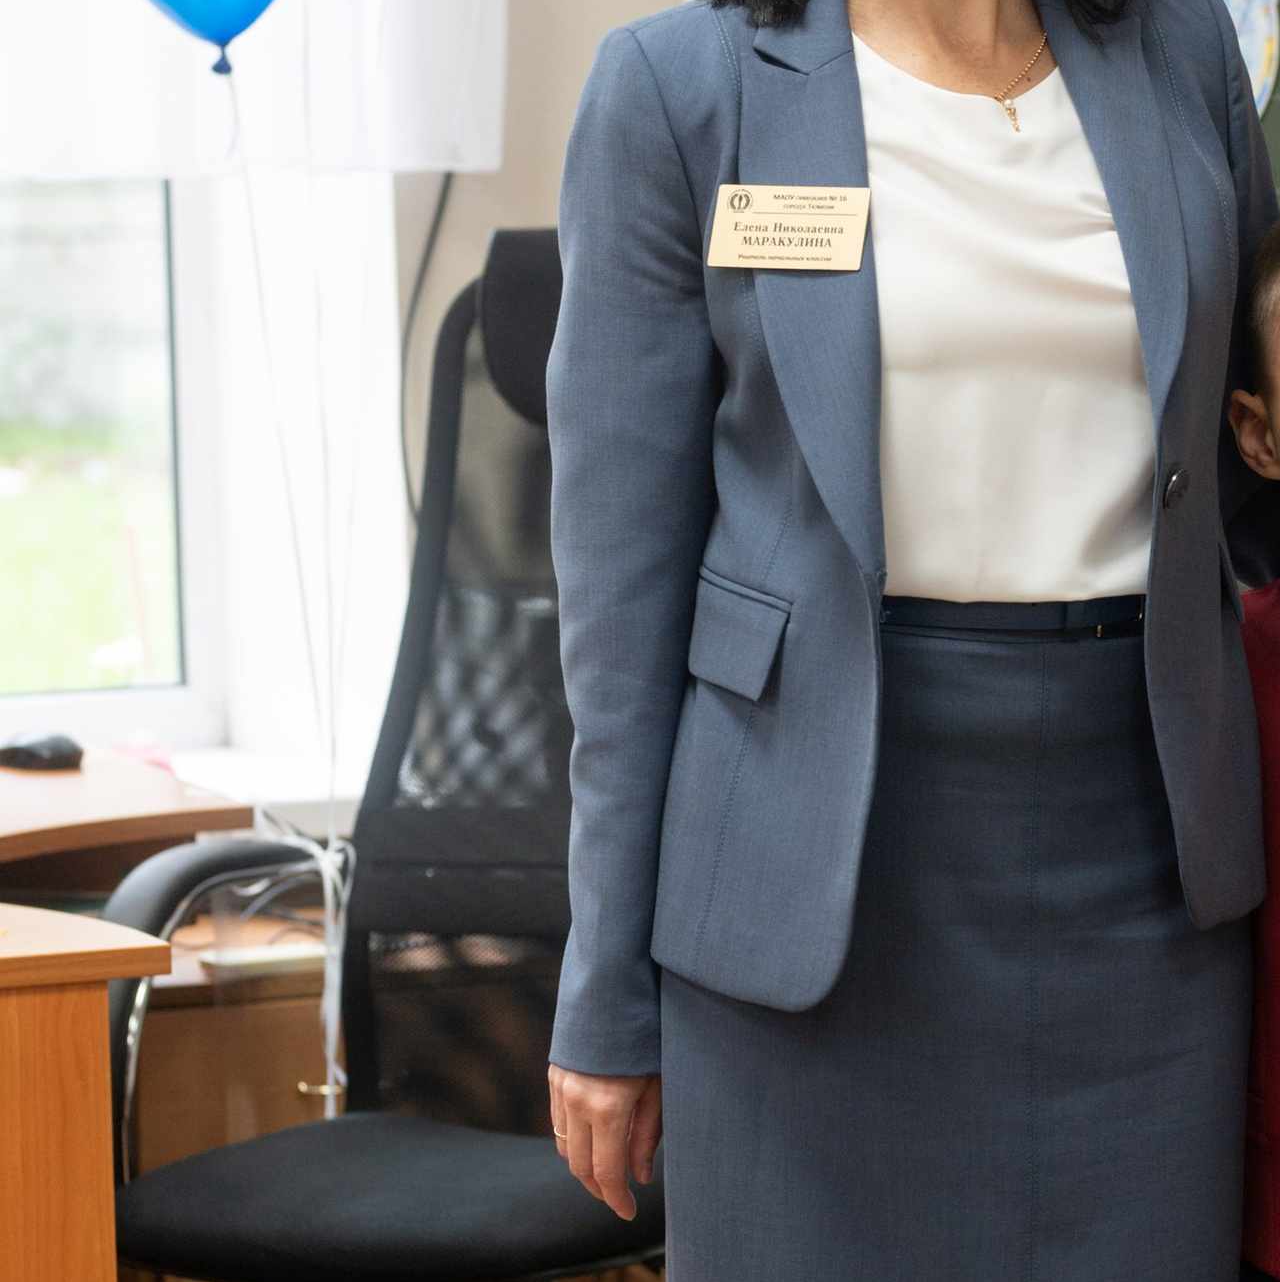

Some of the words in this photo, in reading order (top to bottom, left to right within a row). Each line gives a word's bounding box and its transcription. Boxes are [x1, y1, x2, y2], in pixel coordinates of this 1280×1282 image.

[734, 221, 768, 232] Елена
[773, 223, 844, 234] Николаевна
[741, 236, 832, 248] МАРАКУЛИНА
